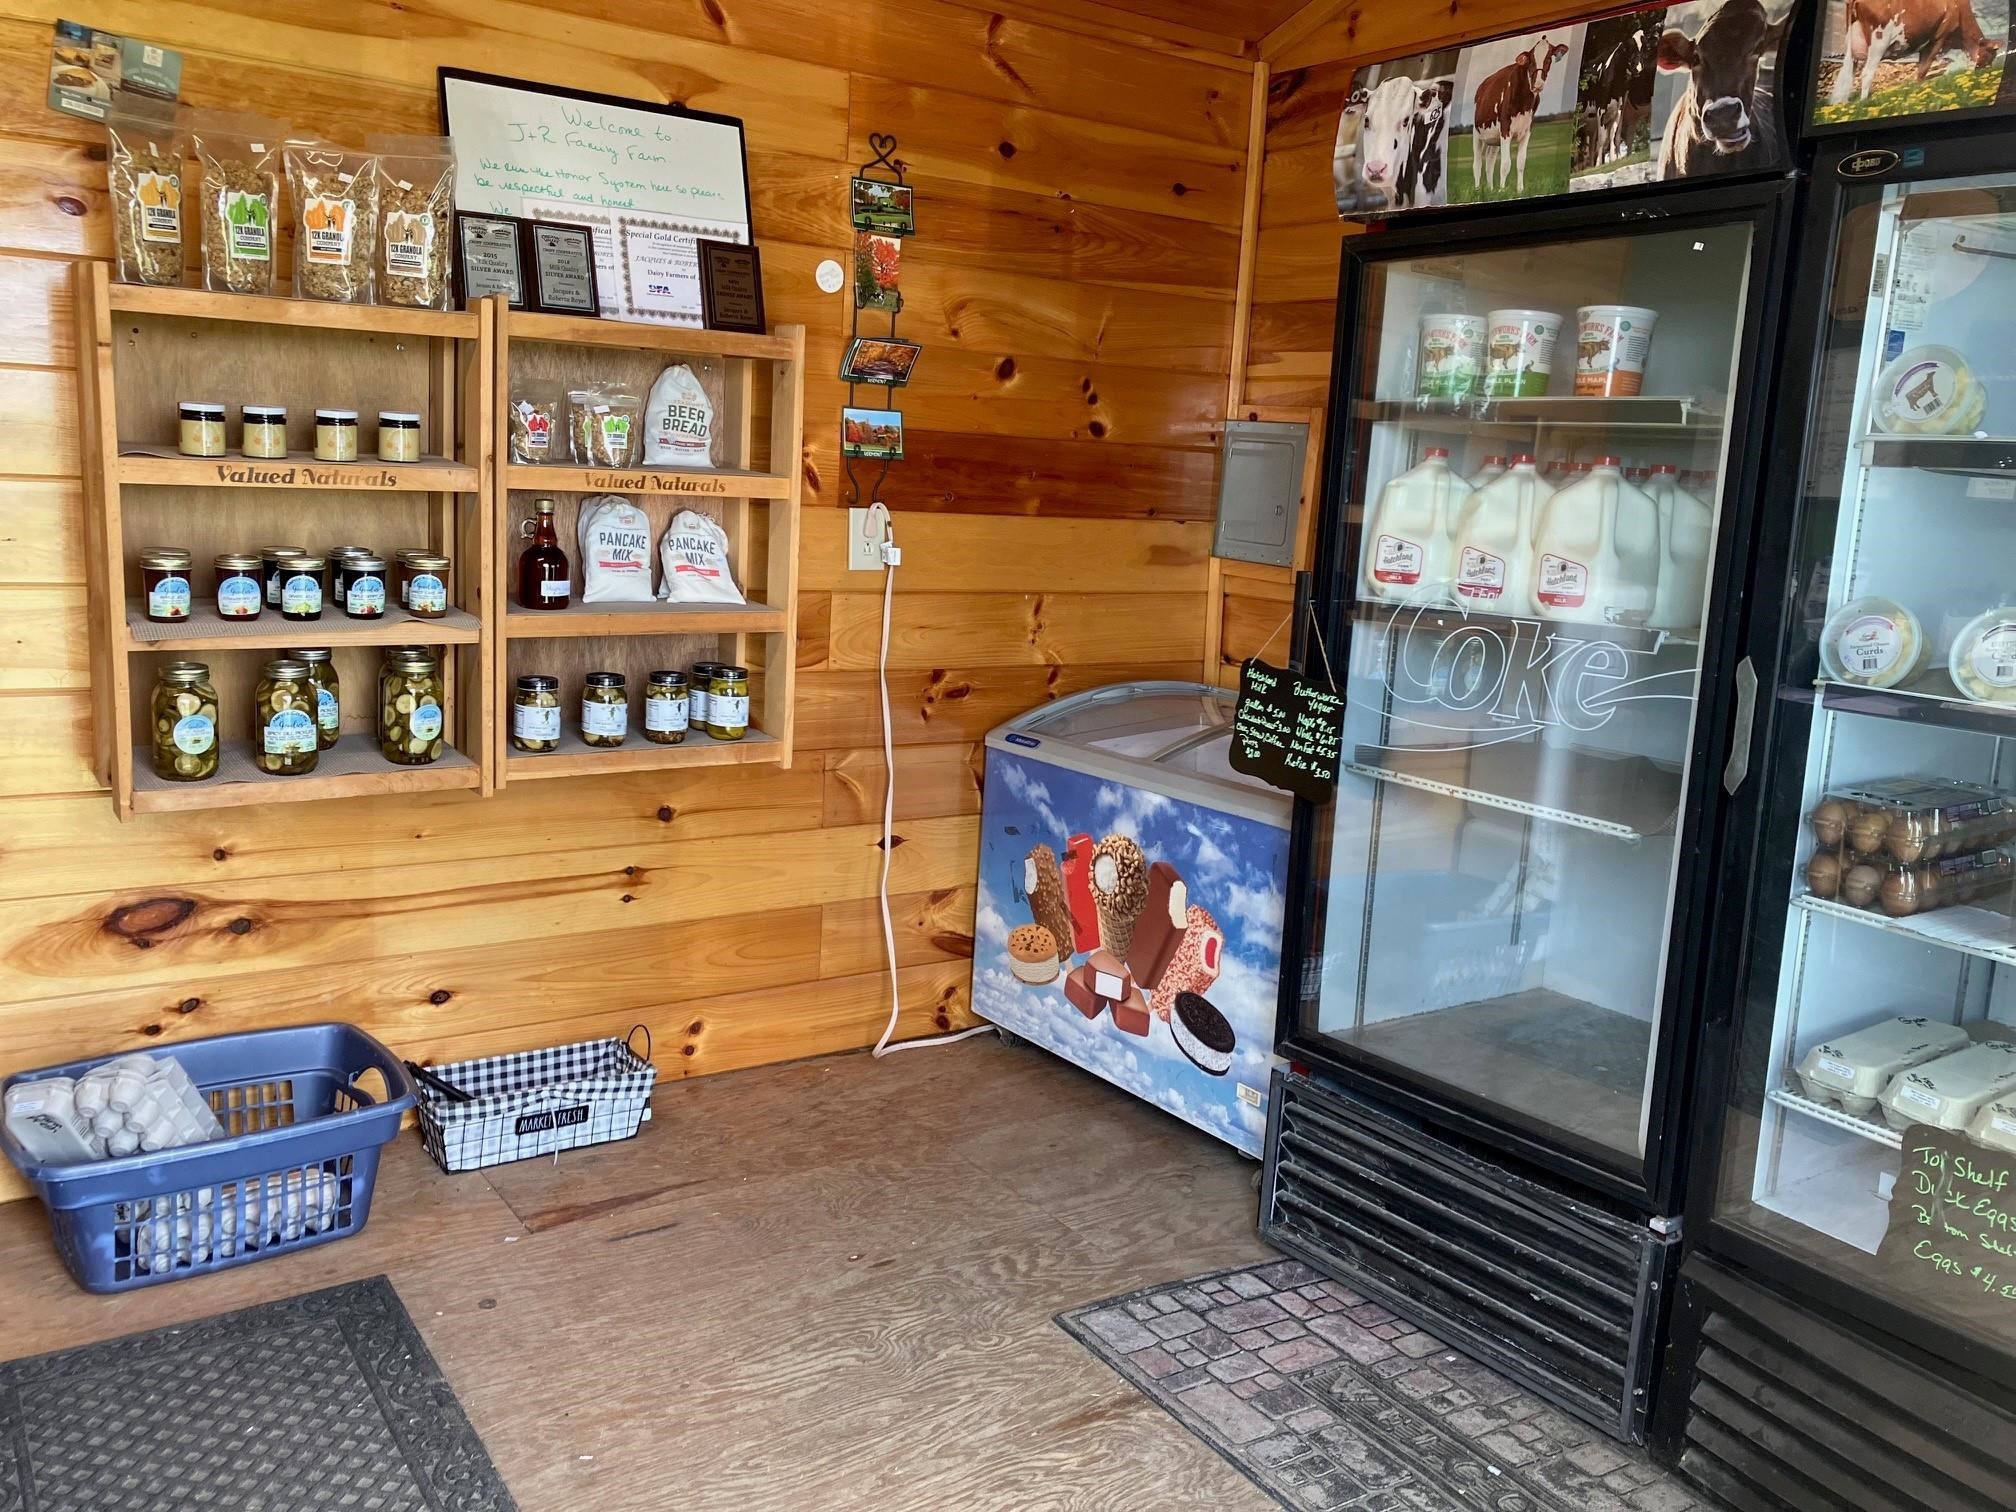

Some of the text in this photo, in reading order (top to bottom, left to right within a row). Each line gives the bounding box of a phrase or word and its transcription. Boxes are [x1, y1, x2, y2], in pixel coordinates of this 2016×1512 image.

[560, 106, 672, 142] Welcome to
[507, 123, 666, 164] J+R Family Farm
[480, 158, 500, 172] We
[598, 172, 646, 192] System
[474, 174, 636, 208] be respectful and honest
[489, 200, 512, 215] We
[244, 226, 265, 237] GRANOLA
[322, 231, 344, 242] GRANOL
[625, 228, 652, 240] Special
[654, 232, 672, 242] Gold
[400, 245, 422, 255] GRANOLA
[492, 268, 514, 276] AWARD
[647, 269, 664, 278] Dairy
[665, 271, 688, 280] Farmers
[668, 404, 705, 423] BEER
[662, 418, 708, 438] BREAD
[216, 465, 398, 488] Valued Naturals
[584, 472, 726, 493] Valued Naturals
[600, 532, 647, 550] PANCAKE
[668, 538, 716, 555] PANCAKE
[612, 548, 634, 562] MIX
[685, 552, 706, 566] MIX
[1382, 584, 1628, 730] Coke
[1856, 647, 1884, 656] Curds
[1250, 681, 1268, 694] Milk
[1954, 1156, 2009, 1192] Shelf
[1913, 1240, 1962, 1276] Eggs
